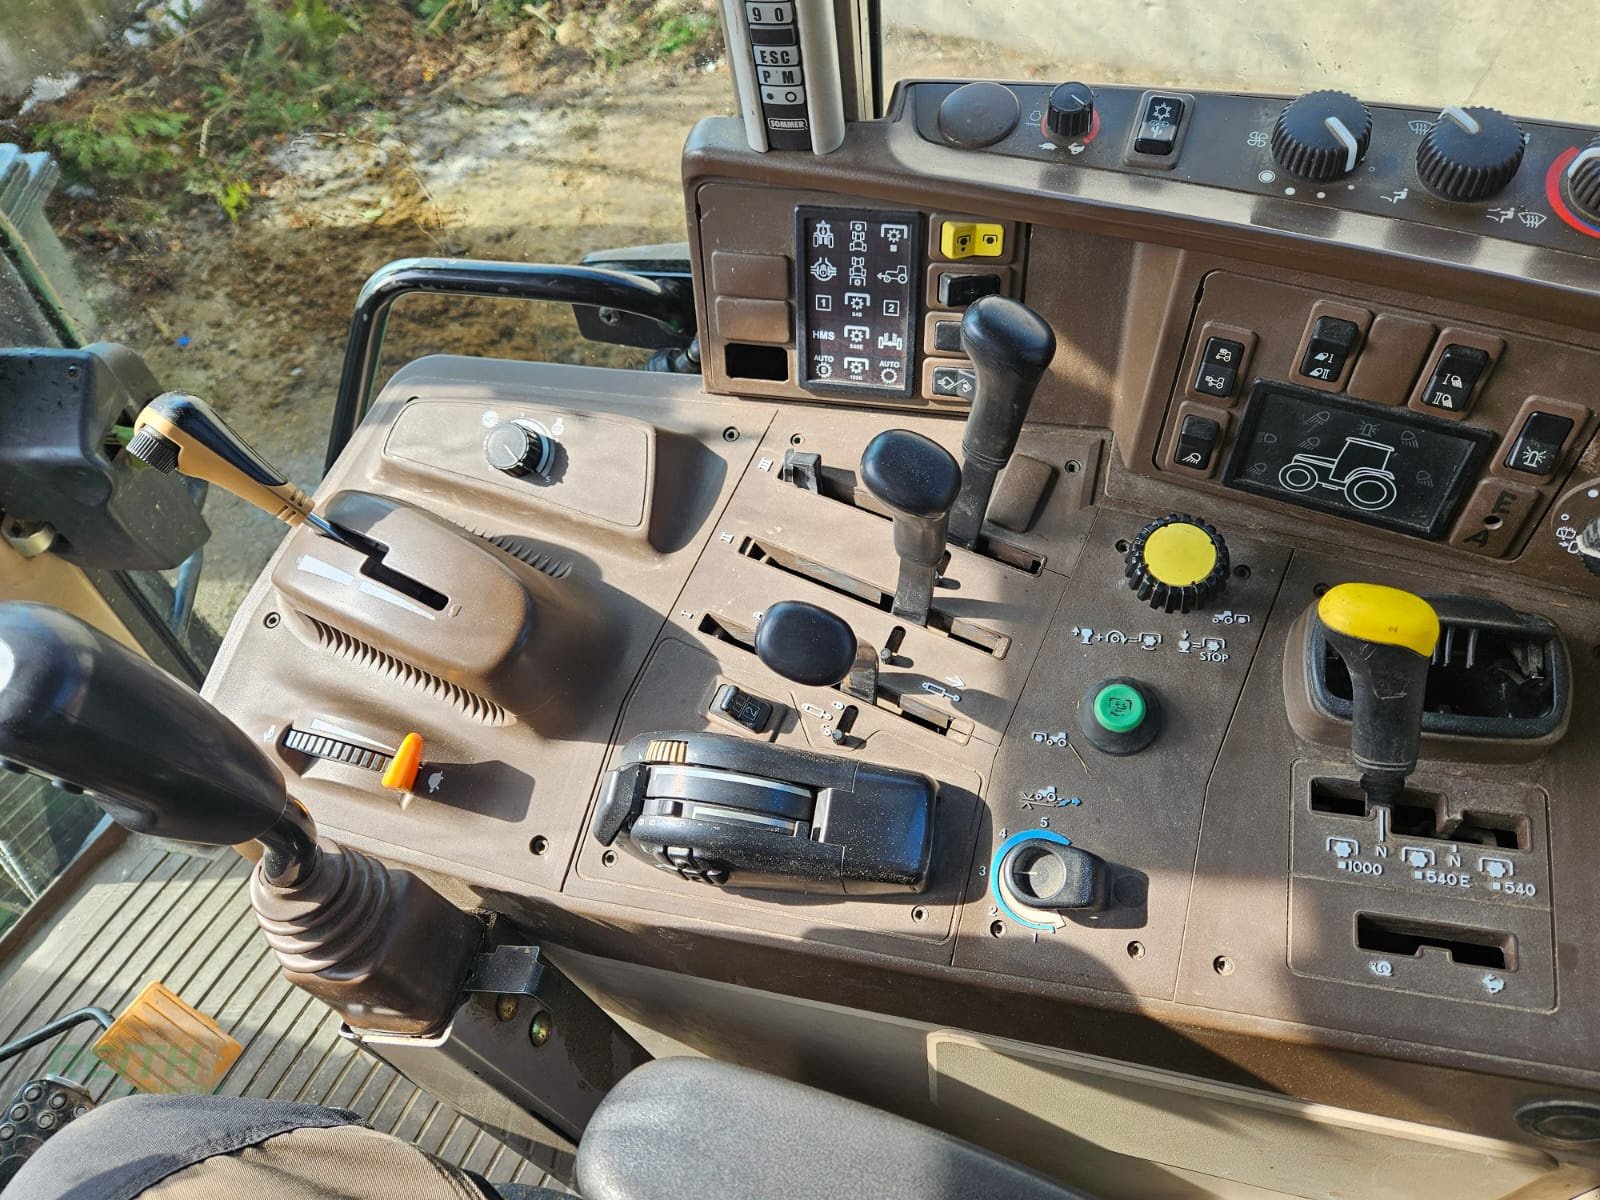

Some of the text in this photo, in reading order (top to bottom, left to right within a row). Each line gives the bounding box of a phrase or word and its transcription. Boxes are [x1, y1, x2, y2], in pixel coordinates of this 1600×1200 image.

[752, 7, 784, 21] 9 0
[759, 50, 790, 64] ESC
[762, 70, 795, 84] P M
[770, 119, 805, 129] SOMMER
[888, 303, 895, 312] 2
[812, 330, 835, 340] HMS
[813, 354, 834, 362] AUTO
[879, 360, 900, 368] AUTO
[1199, 652, 1229, 663] STOP
[1040, 817, 1049, 828] 5
[1000, 828, 1008, 838] 4
[1376, 846, 1388, 858] N
[1449, 854, 1461, 868] N
[979, 865, 987, 877] 3
[1347, 860, 1383, 876] 1000
[1426, 870, 1471, 888] 540 E
[1504, 881, 1536, 897] 540
[988, 905, 998, 917] 2
